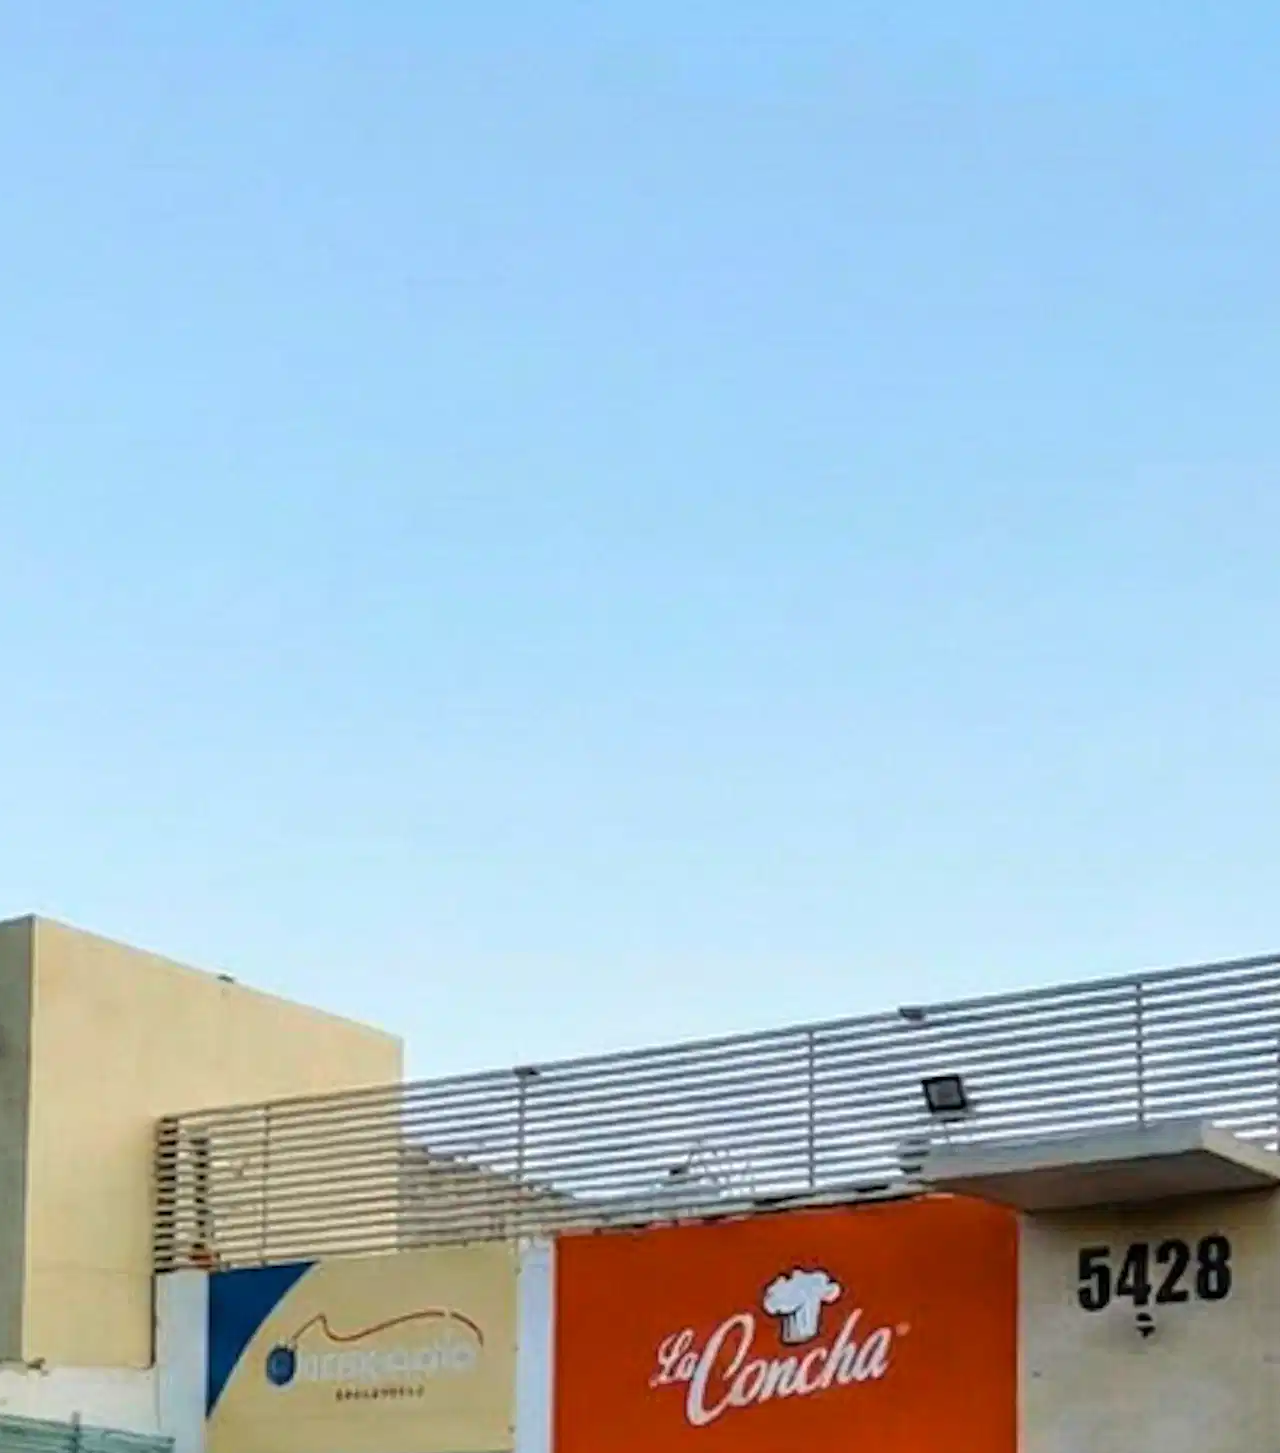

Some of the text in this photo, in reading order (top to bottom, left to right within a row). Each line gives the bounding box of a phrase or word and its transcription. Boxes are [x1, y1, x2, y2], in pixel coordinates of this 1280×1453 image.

[1078, 1235, 1231, 1312] 5428
[651, 1309, 889, 1425] La Concha
